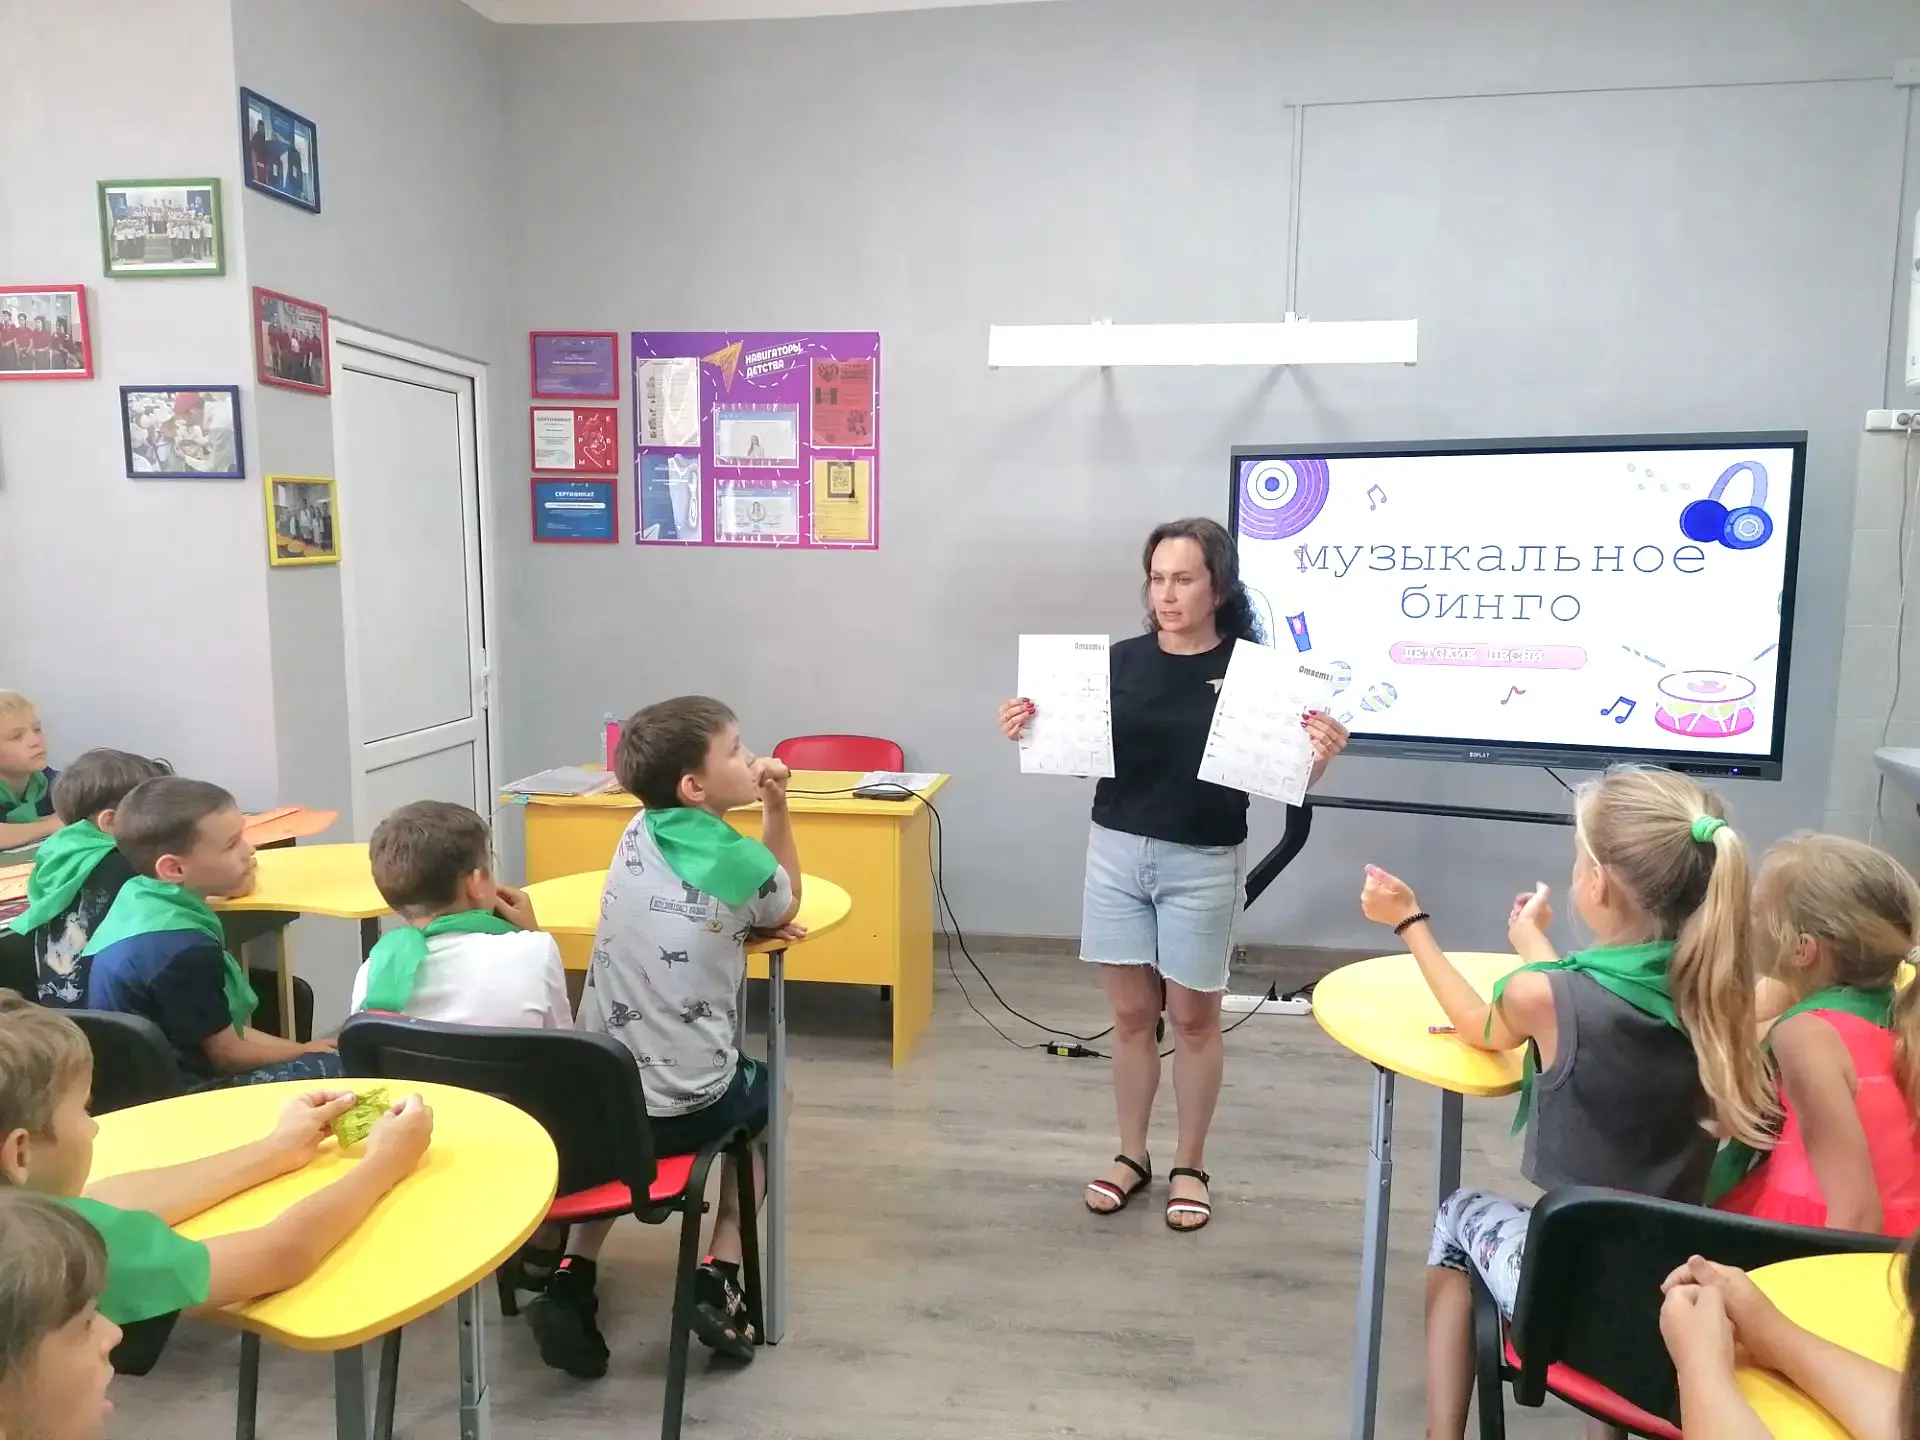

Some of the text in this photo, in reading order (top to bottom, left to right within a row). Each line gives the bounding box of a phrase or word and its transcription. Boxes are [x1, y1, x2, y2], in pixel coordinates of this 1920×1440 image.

[745, 342, 803, 365] НАВИГАТОРЫ
[746, 359, 784, 379] ДЕТСТВА
[1297, 545, 1705, 577] музыкальное
[1401, 584, 1581, 621] бинго
